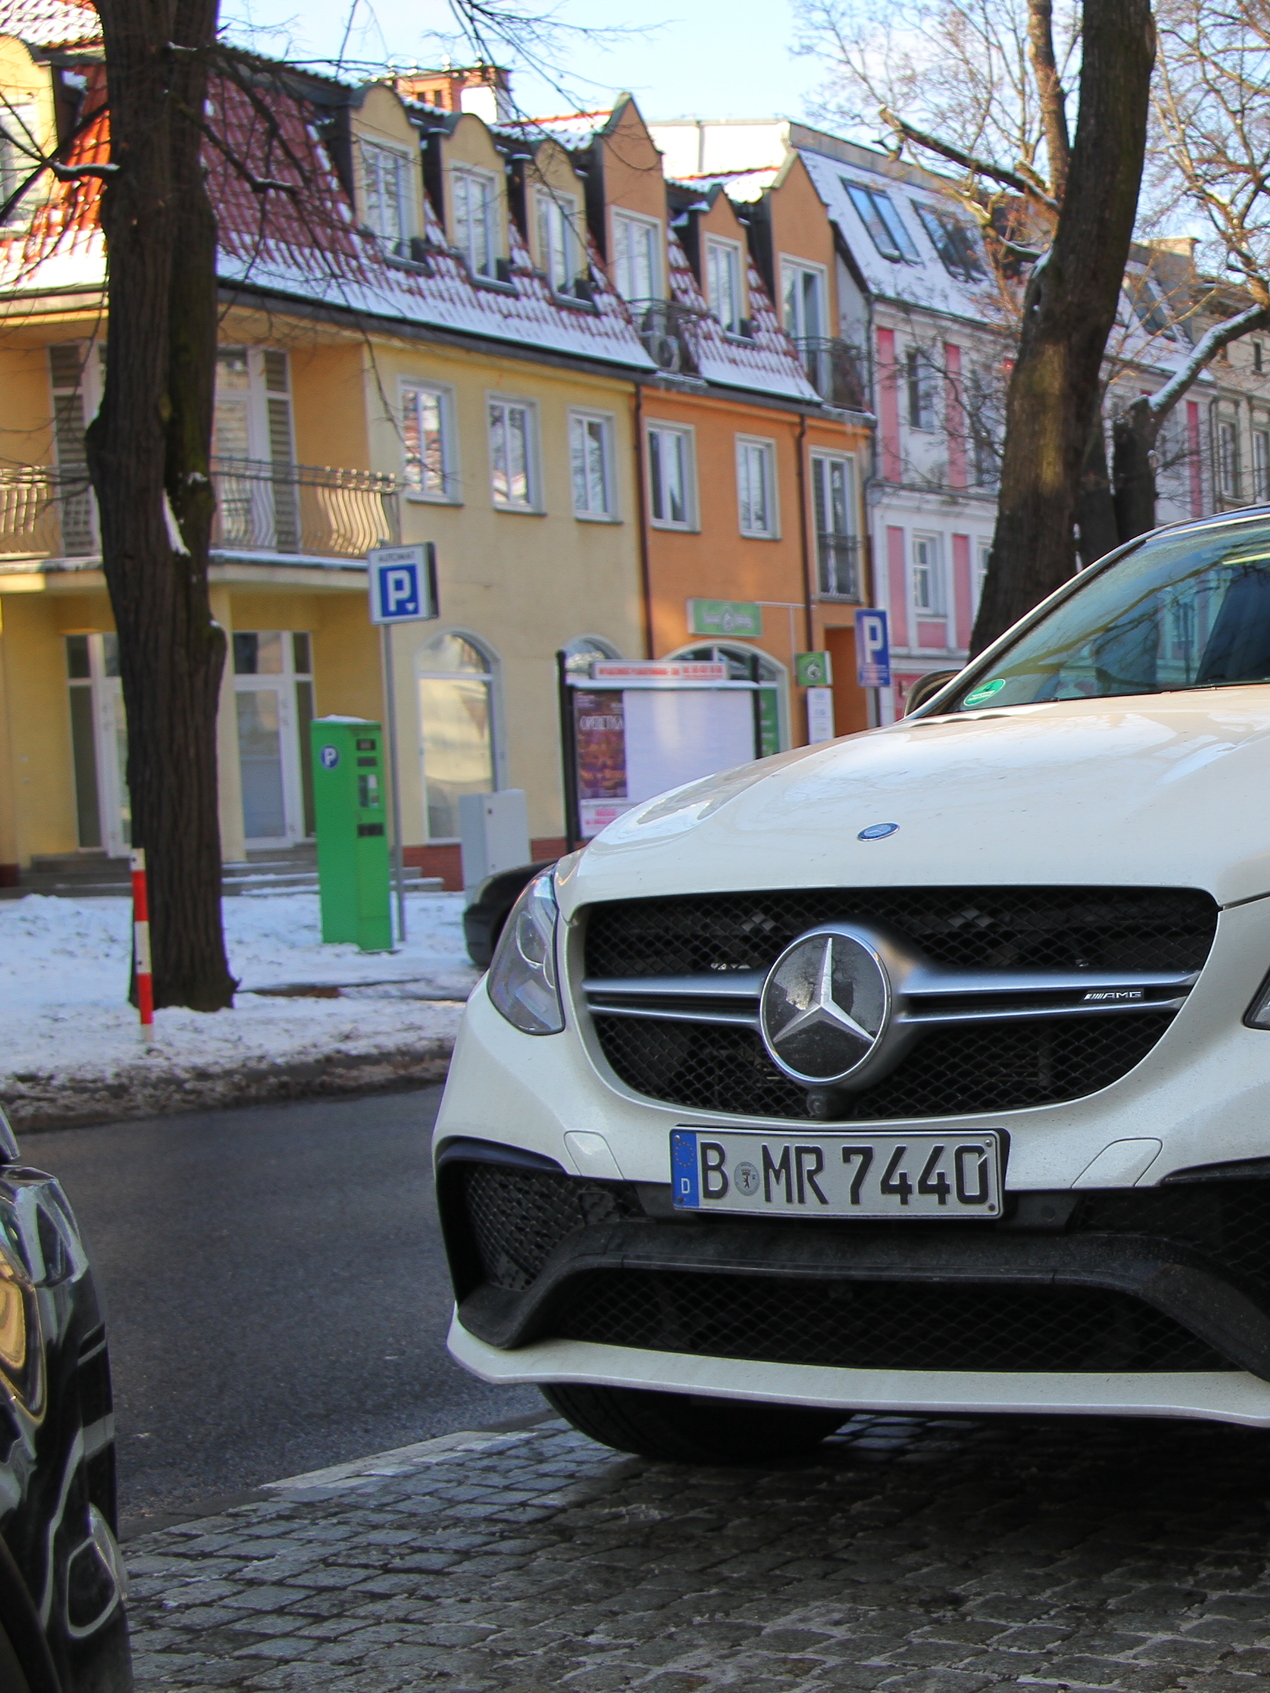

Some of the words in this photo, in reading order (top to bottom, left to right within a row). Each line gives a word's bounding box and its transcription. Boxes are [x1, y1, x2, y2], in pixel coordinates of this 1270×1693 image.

[387, 569, 412, 612] P
[862, 616, 884, 664] P
[323, 747, 337, 766] P
[681, 1178, 690, 1194] D
[700, 1141, 729, 1199] B
[761, 1143, 829, 1205] MR
[841, 1144, 989, 1206] 7440
